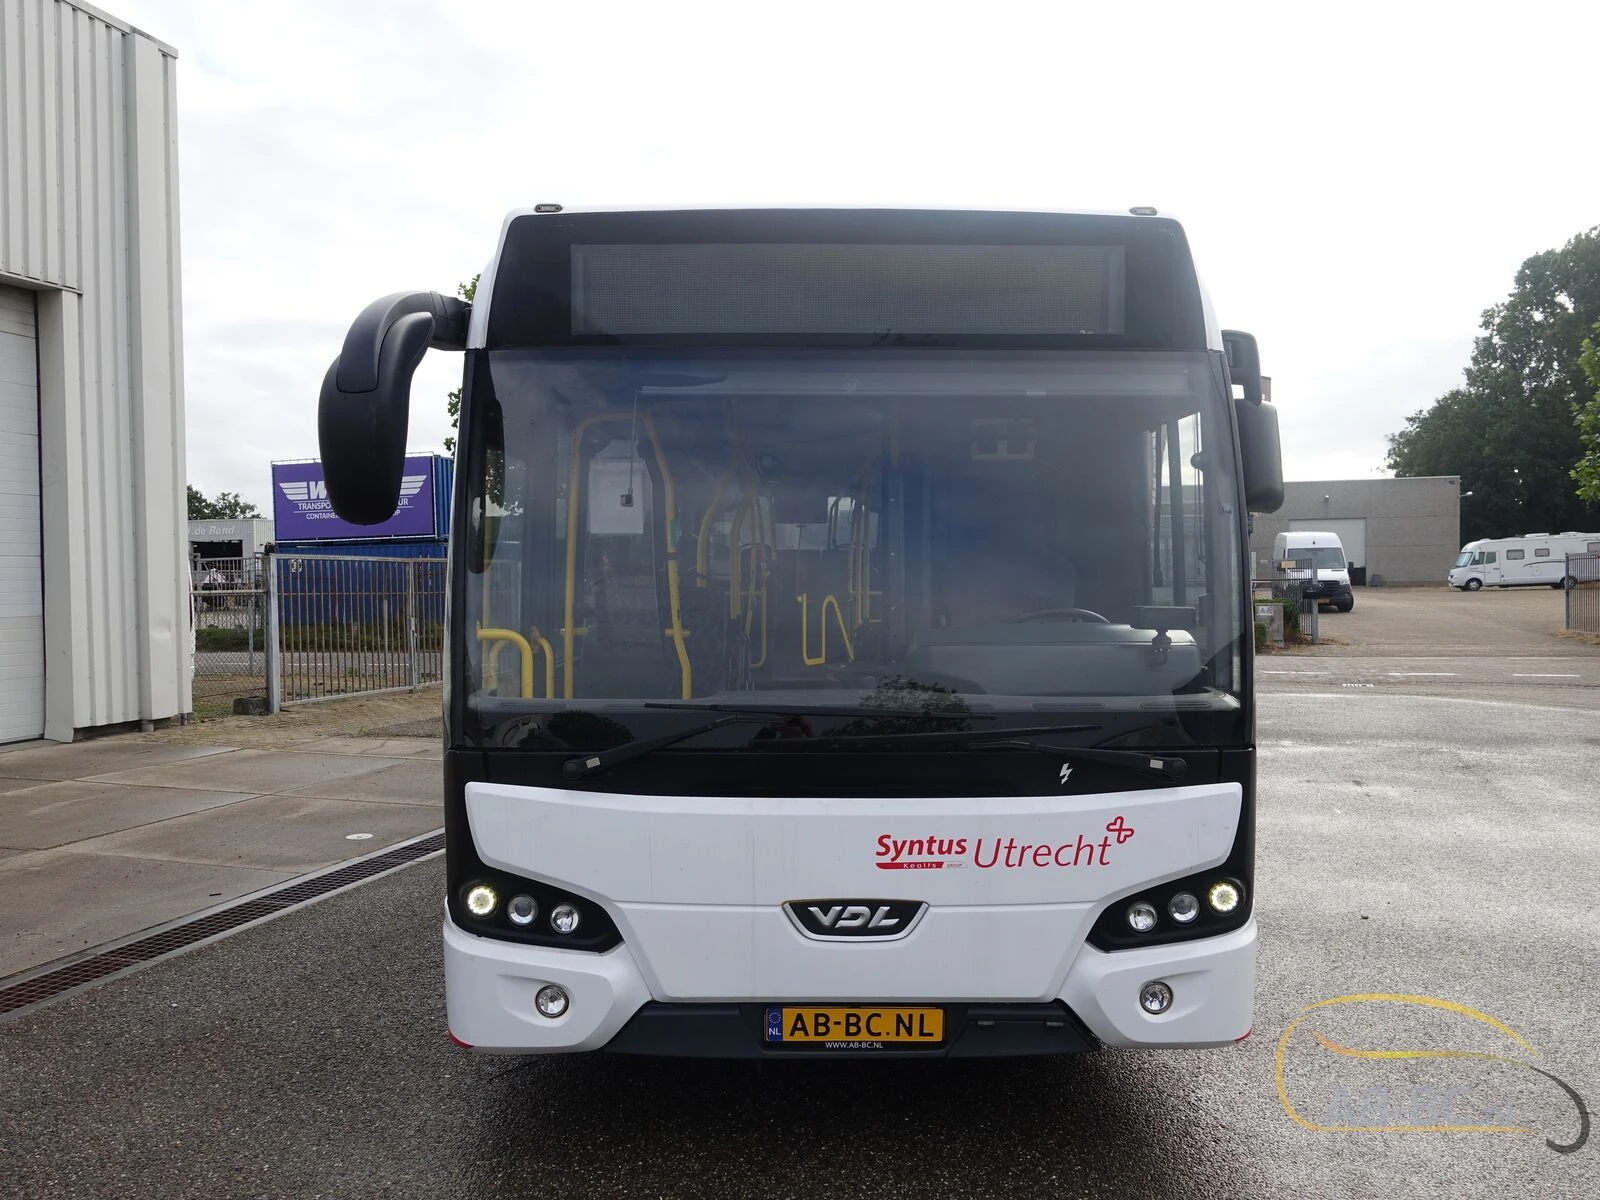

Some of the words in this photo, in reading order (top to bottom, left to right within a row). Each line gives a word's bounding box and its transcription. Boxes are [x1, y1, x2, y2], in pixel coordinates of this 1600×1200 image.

[298, 501, 332, 511] TRANSPO
[306, 512, 340, 520] CONTAINE
[875, 834, 967, 863] Syntus
[973, 834, 1112, 868] Utrecht
[807, 906, 900, 928] VDL
[768, 1027, 781, 1036] NL
[789, 1013, 934, 1038] AB-BC.NL
[825, 1041, 884, 1049] WWW.AB-BC.NL
